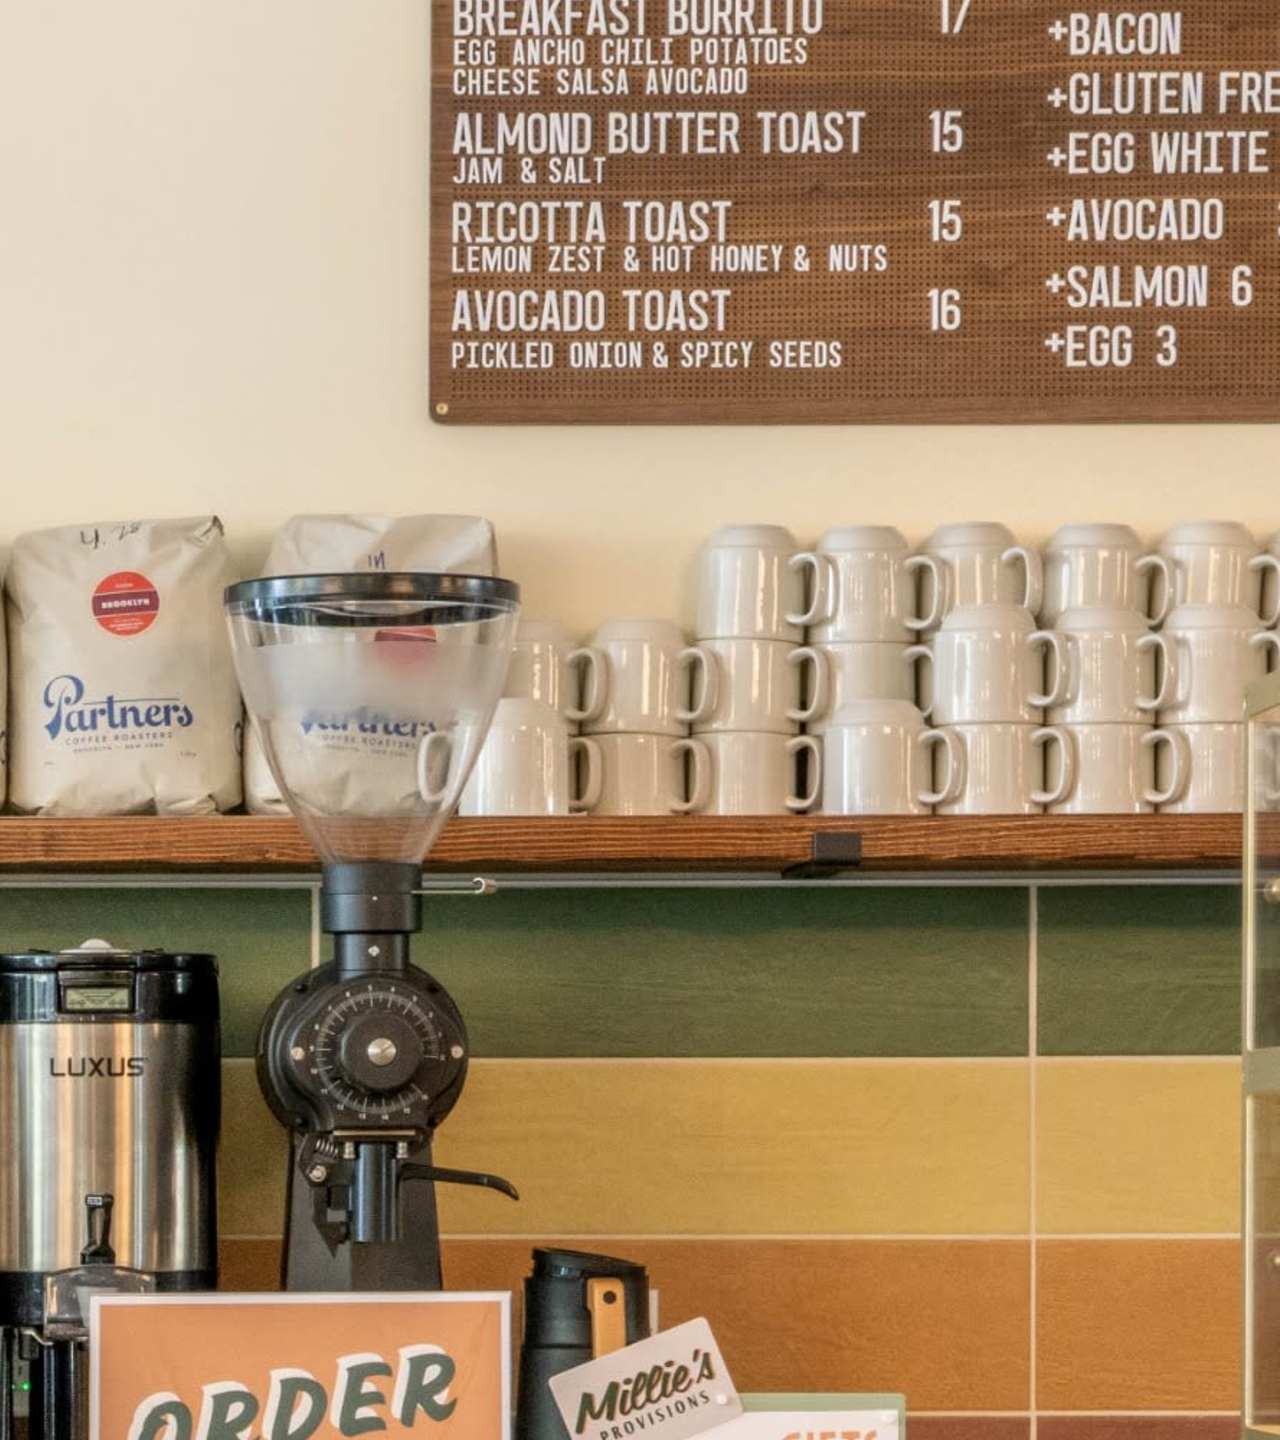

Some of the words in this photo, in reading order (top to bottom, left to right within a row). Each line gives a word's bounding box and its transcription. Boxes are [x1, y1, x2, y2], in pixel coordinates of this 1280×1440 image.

[452, 112, 592, 155] ALMOND
[608, 111, 740, 154] BUTTER
[757, 111, 866, 154] TOAST
[929, 110, 963, 152] 15
[1231, 265, 1252, 306] 6
[452, 341, 554, 369] PICKLED
[569, 341, 642, 369] ONION
[652, 341, 669, 368] &
[681, 341, 753, 368] SPICY
[769, 340, 842, 368] SEEDS
[1156, 324, 1177, 366] 3
[101, 598, 150, 609] BROOKLYN
[43, 674, 193, 740] Partners
[65, 735, 107, 746] COFFEE
[114, 731, 173, 742] ROASTERS
[49, 1057, 144, 1077] LUXUS
[575, 1348, 715, 1435] Millie's
